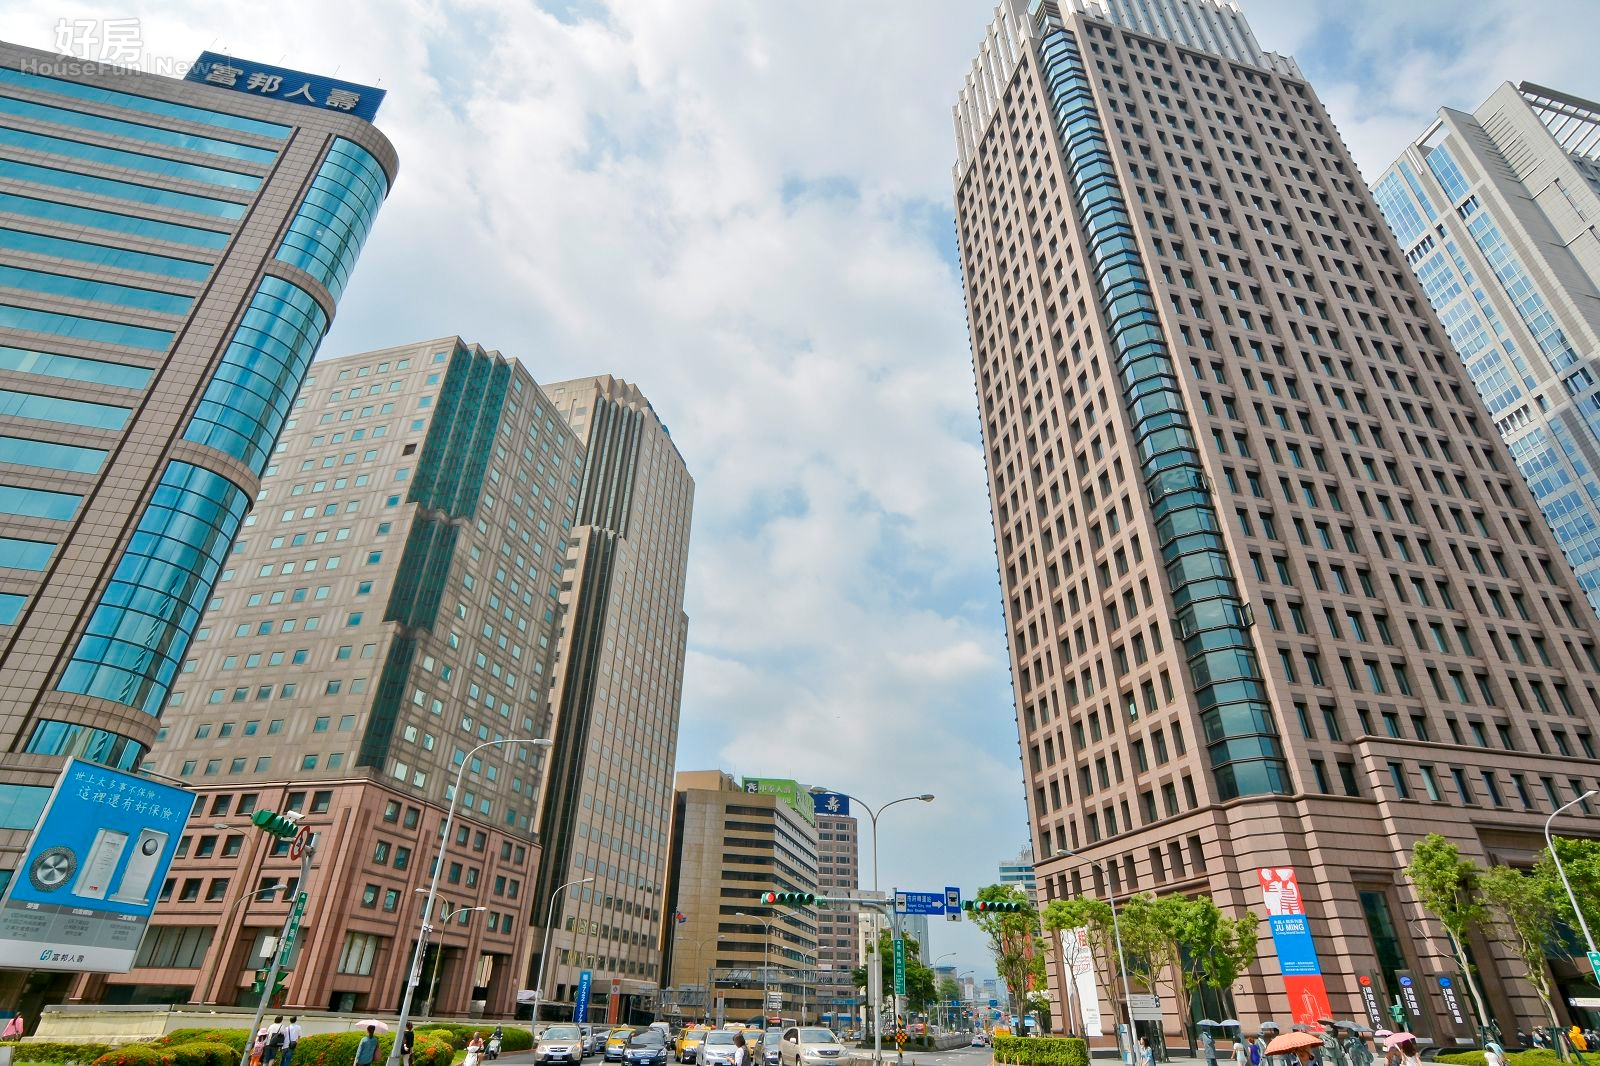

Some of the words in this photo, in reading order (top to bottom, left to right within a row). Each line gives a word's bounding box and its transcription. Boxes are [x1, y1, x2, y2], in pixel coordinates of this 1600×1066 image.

[205, 62, 361, 111] 富邦人壽
[51, 952, 85, 963] 富邦人壽
